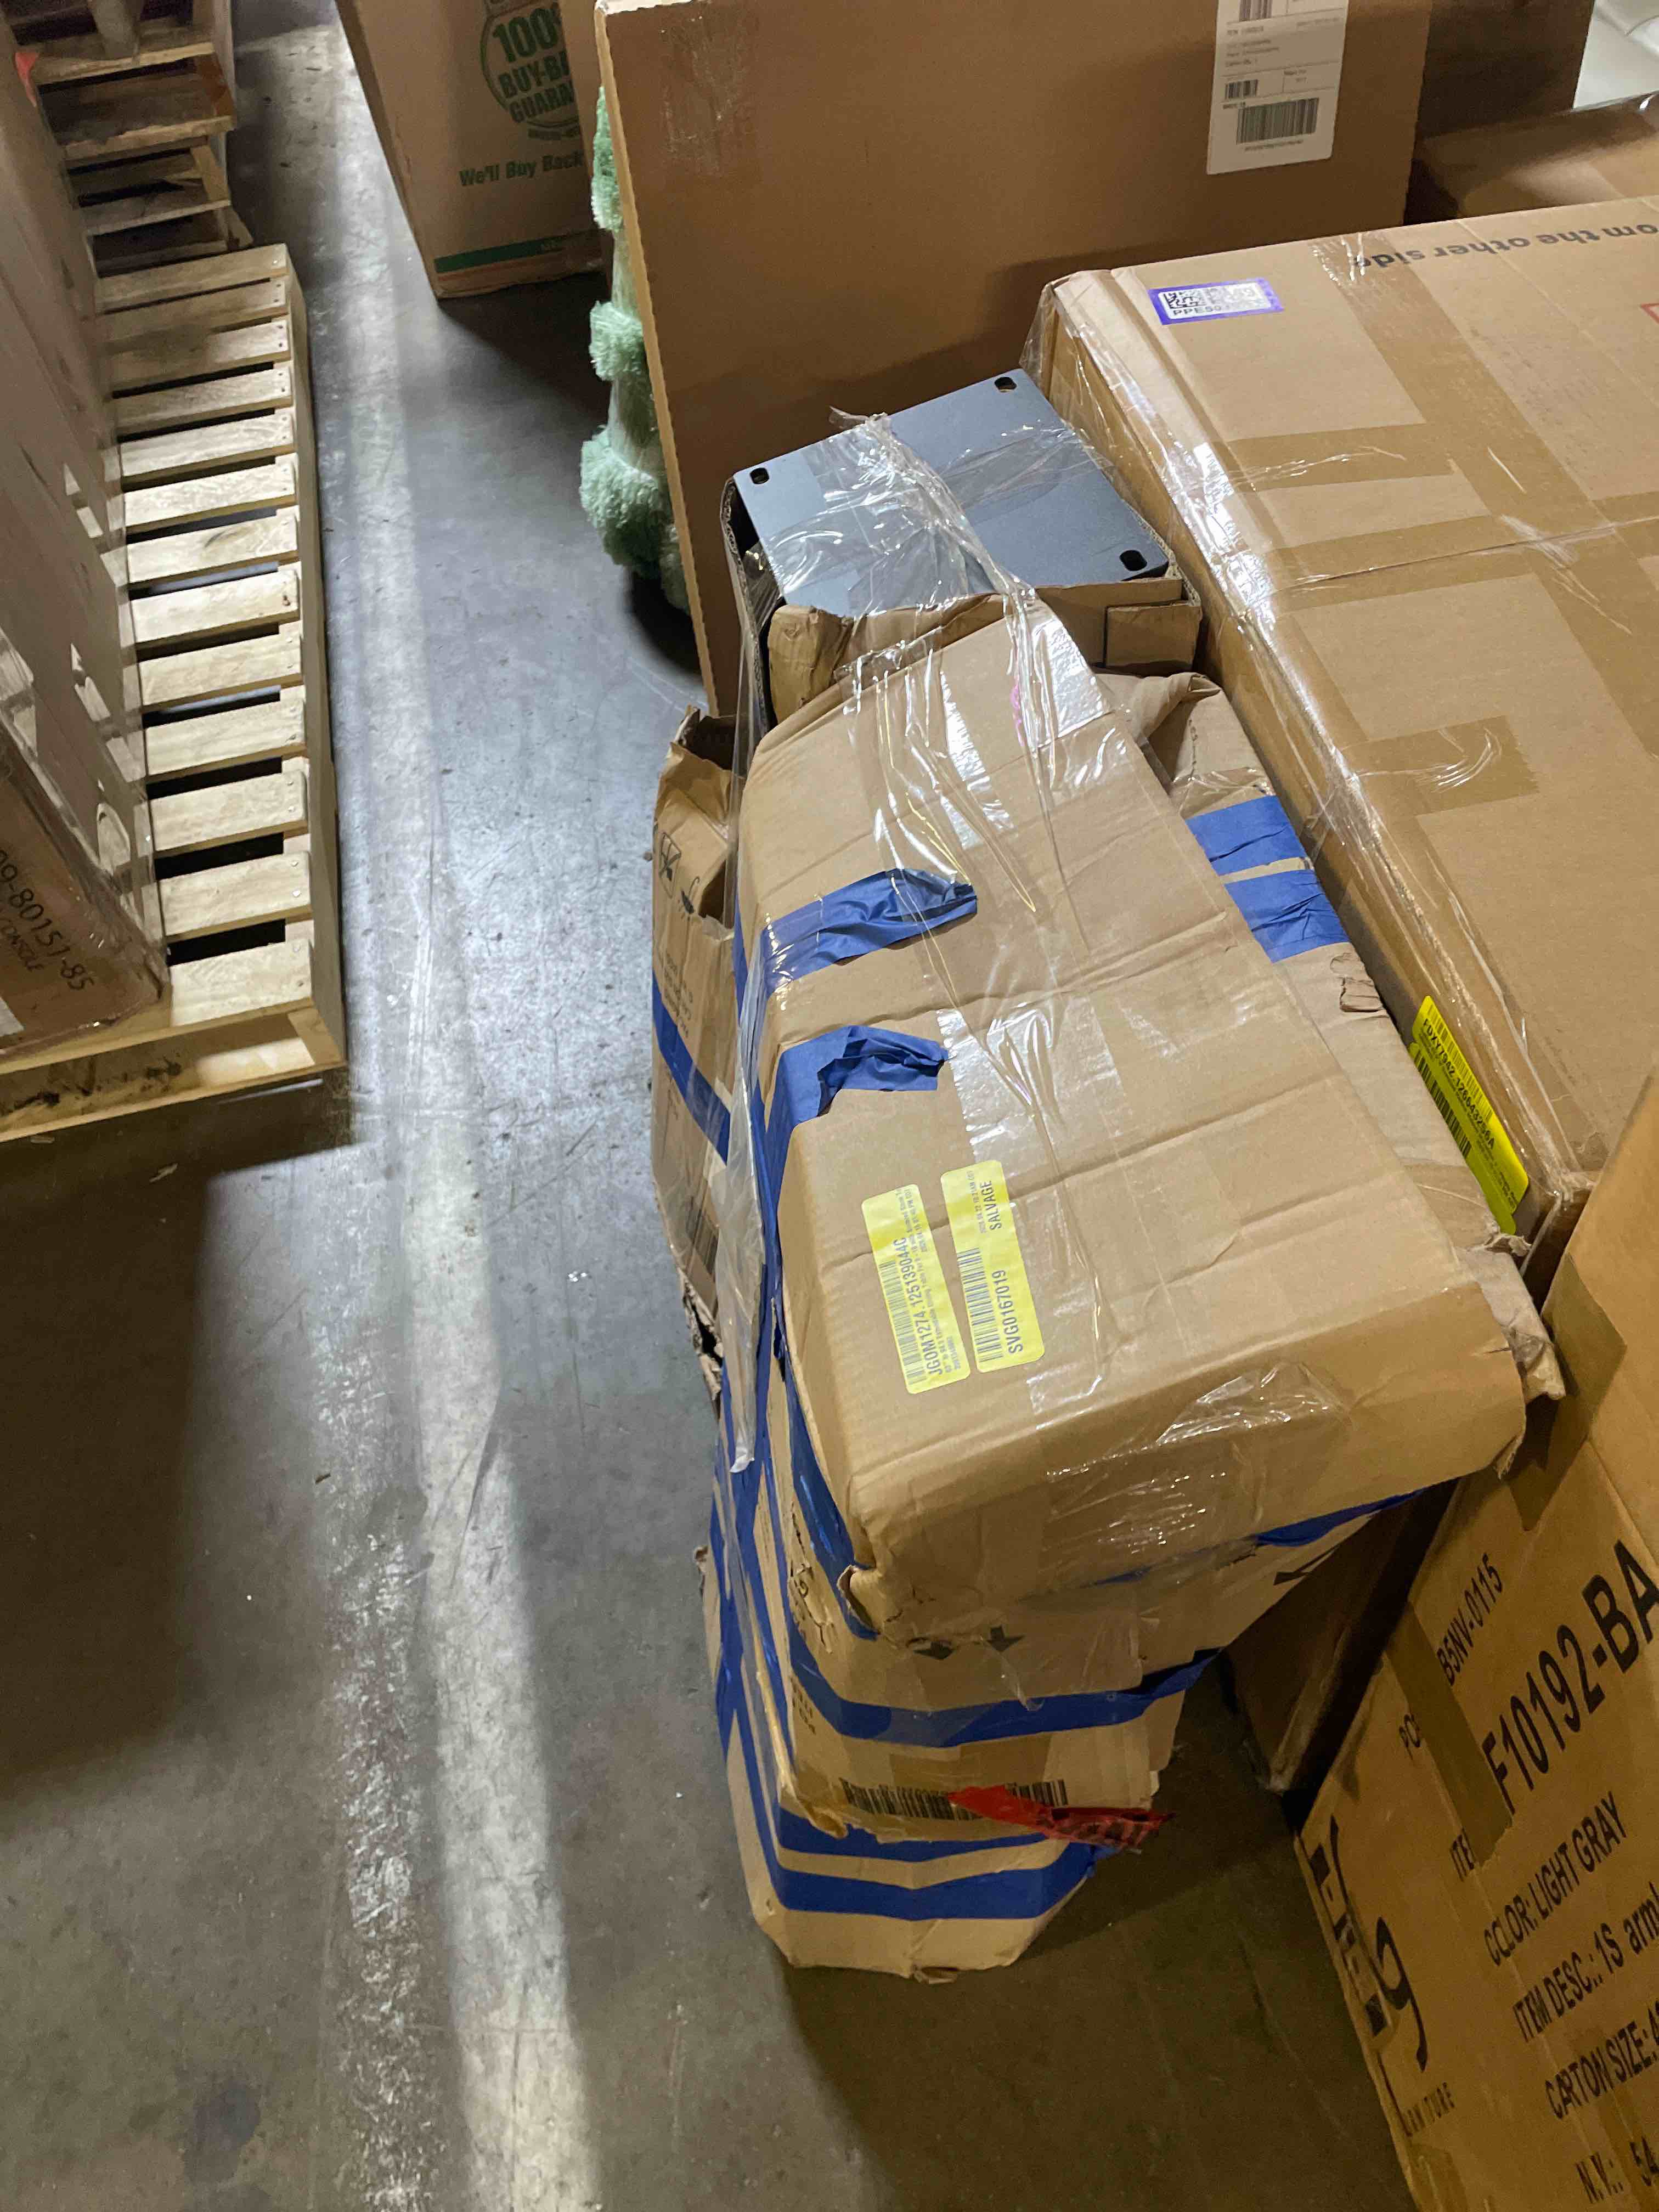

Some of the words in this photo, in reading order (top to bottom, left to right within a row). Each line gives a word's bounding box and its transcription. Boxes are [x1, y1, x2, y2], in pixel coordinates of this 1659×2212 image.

[506, 160, 537, 179] Buy
[1354, 249, 1426, 268] side
[1433, 237, 1531, 258] other
[1536, 229, 1601, 245] the
[980, 1180, 1002, 1231] SALVAGE
[991, 1269, 1023, 1354] SVG0167019
[1449, 1828, 1477, 1882] ITE
[1527, 1841, 1580, 1921] LIGHT
[1571, 1790, 1628, 1873] GRAY
[1544, 2046, 1615, 2120] CARTON
[1606, 2020, 1657, 2083] SIZE:
